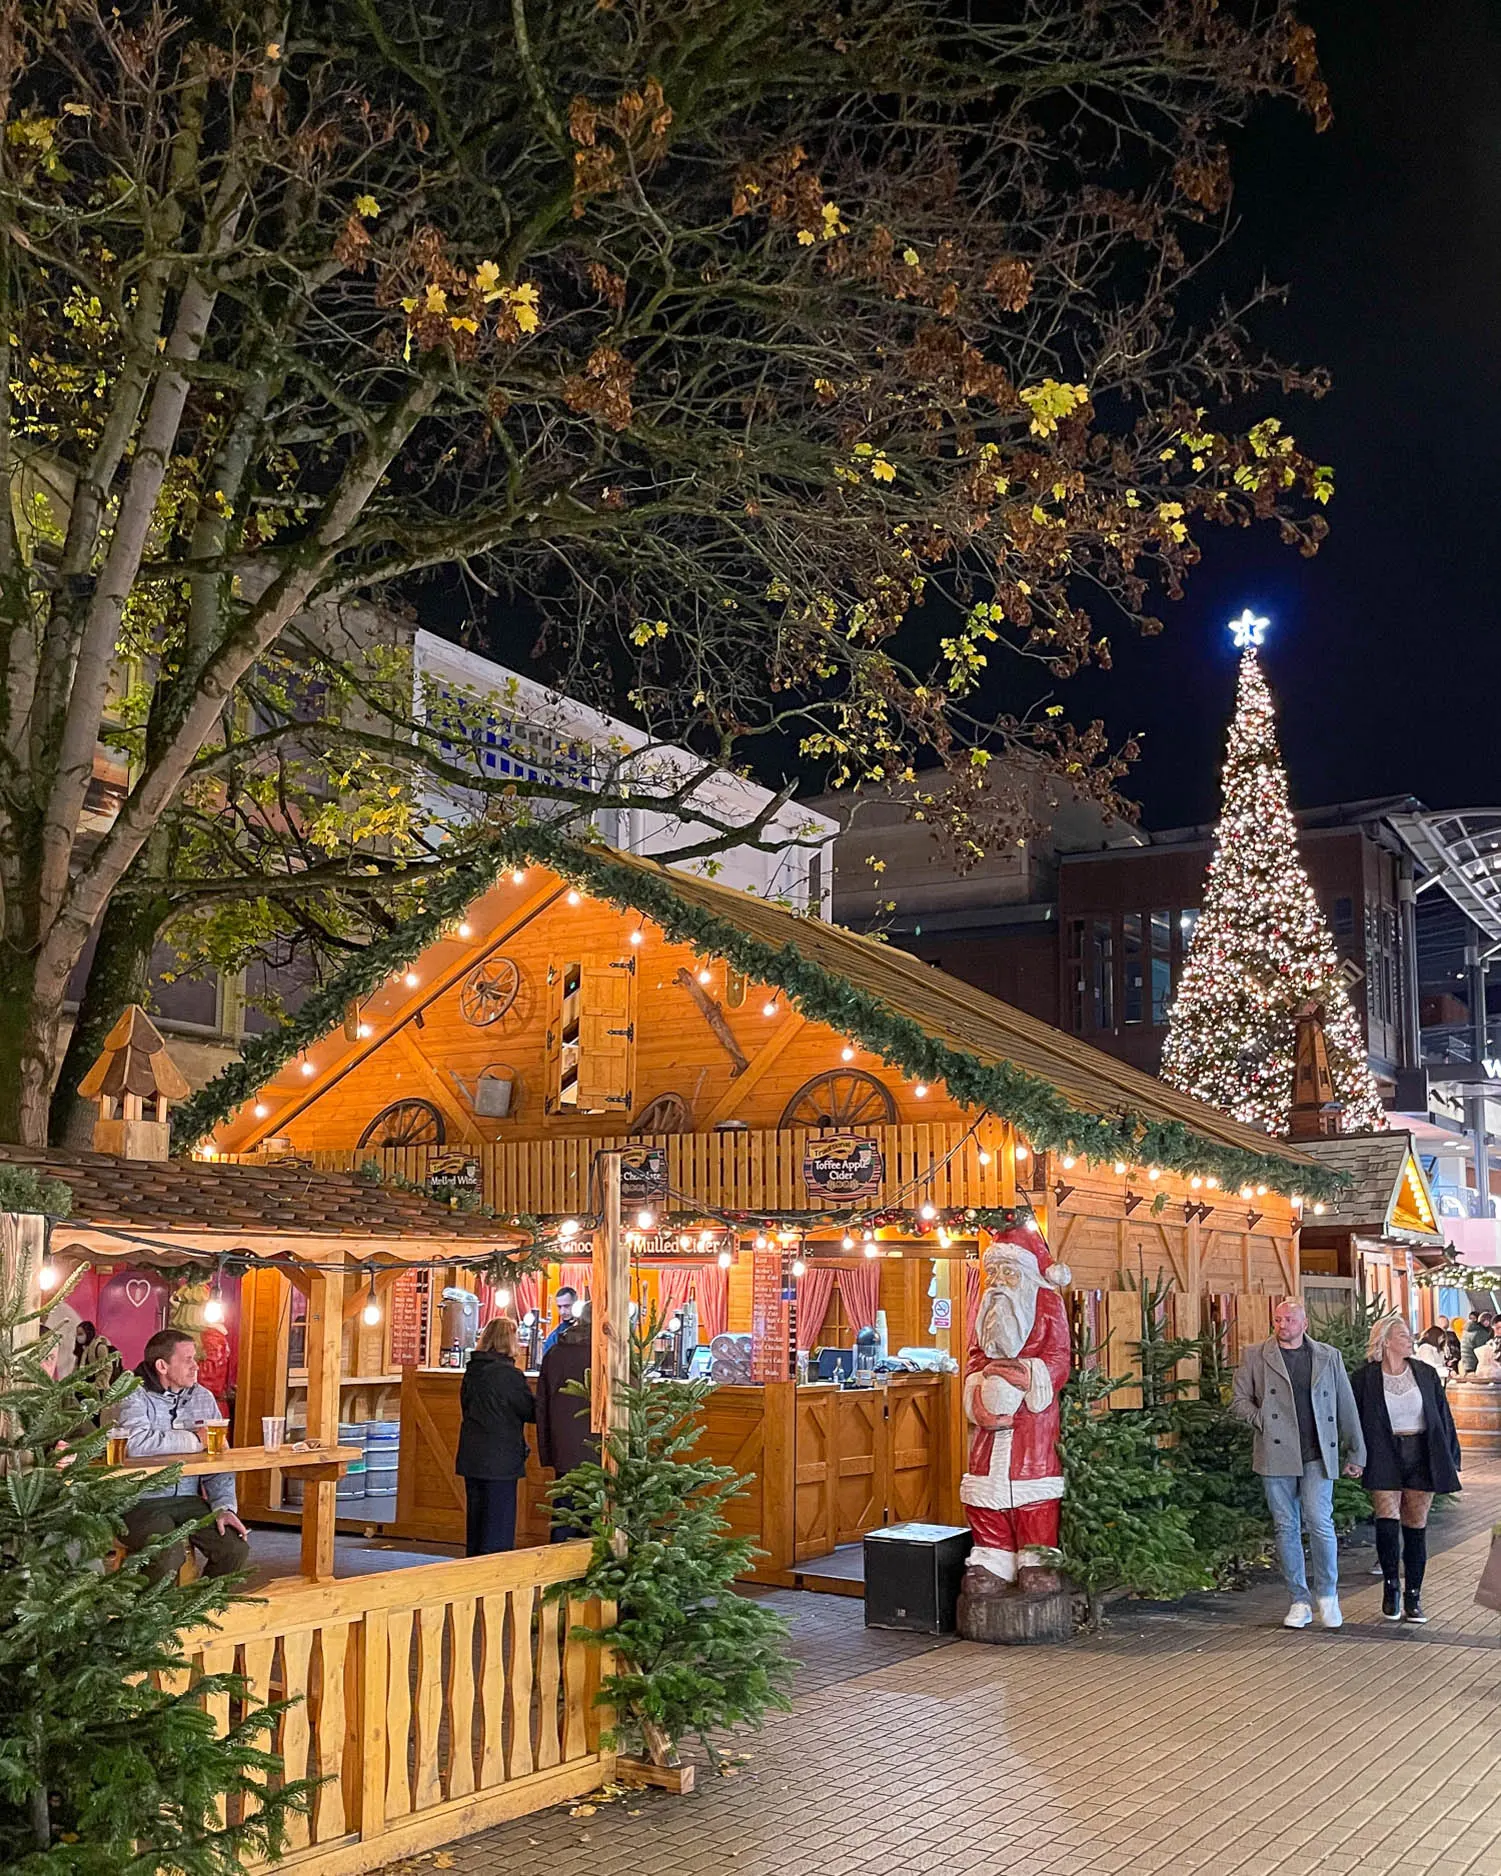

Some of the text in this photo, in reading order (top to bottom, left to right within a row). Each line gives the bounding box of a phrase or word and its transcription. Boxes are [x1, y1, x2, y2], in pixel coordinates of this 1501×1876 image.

[815, 1160, 868, 1172] Toffee Apple
[457, 1175, 477, 1185] Wine
[829, 1171, 854, 1180] Cider
[633, 1235, 680, 1253] Mulled
[682, 1236, 720, 1253] Cider
